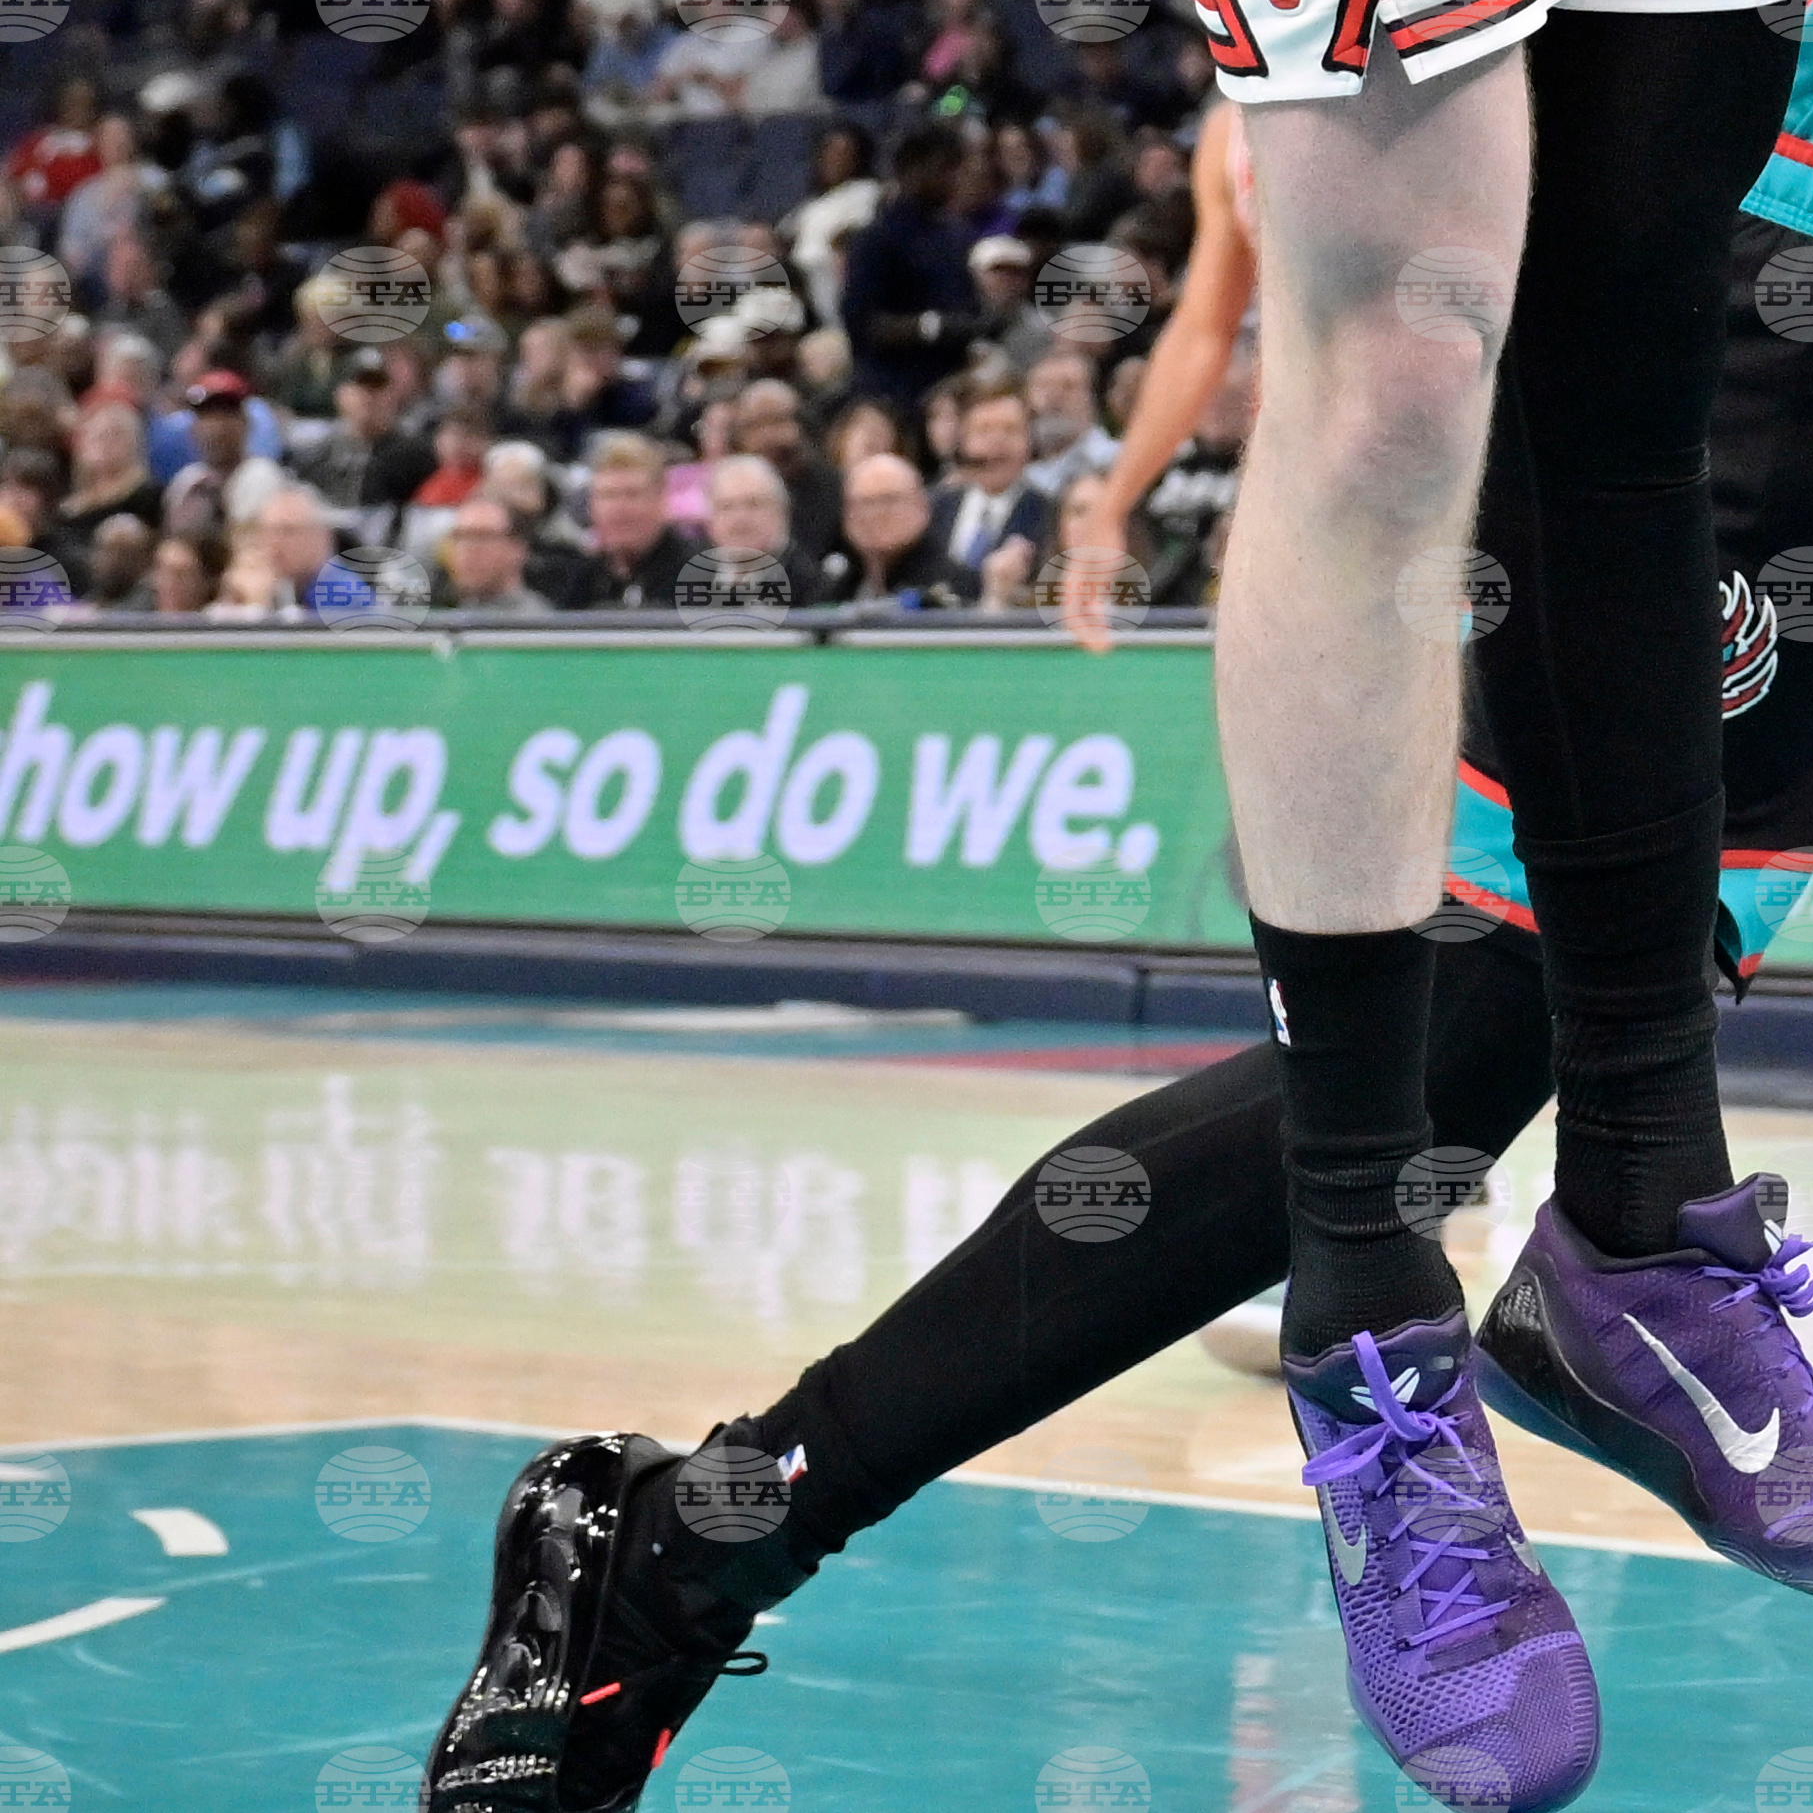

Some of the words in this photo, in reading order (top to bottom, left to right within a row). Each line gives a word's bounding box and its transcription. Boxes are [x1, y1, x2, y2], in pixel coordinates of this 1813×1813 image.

[0, 680, 268, 847] how
[264, 725, 461, 895] up,
[487, 727, 664, 862] so
[677, 681, 880, 866] do
[903, 728, 1162, 875] we.
